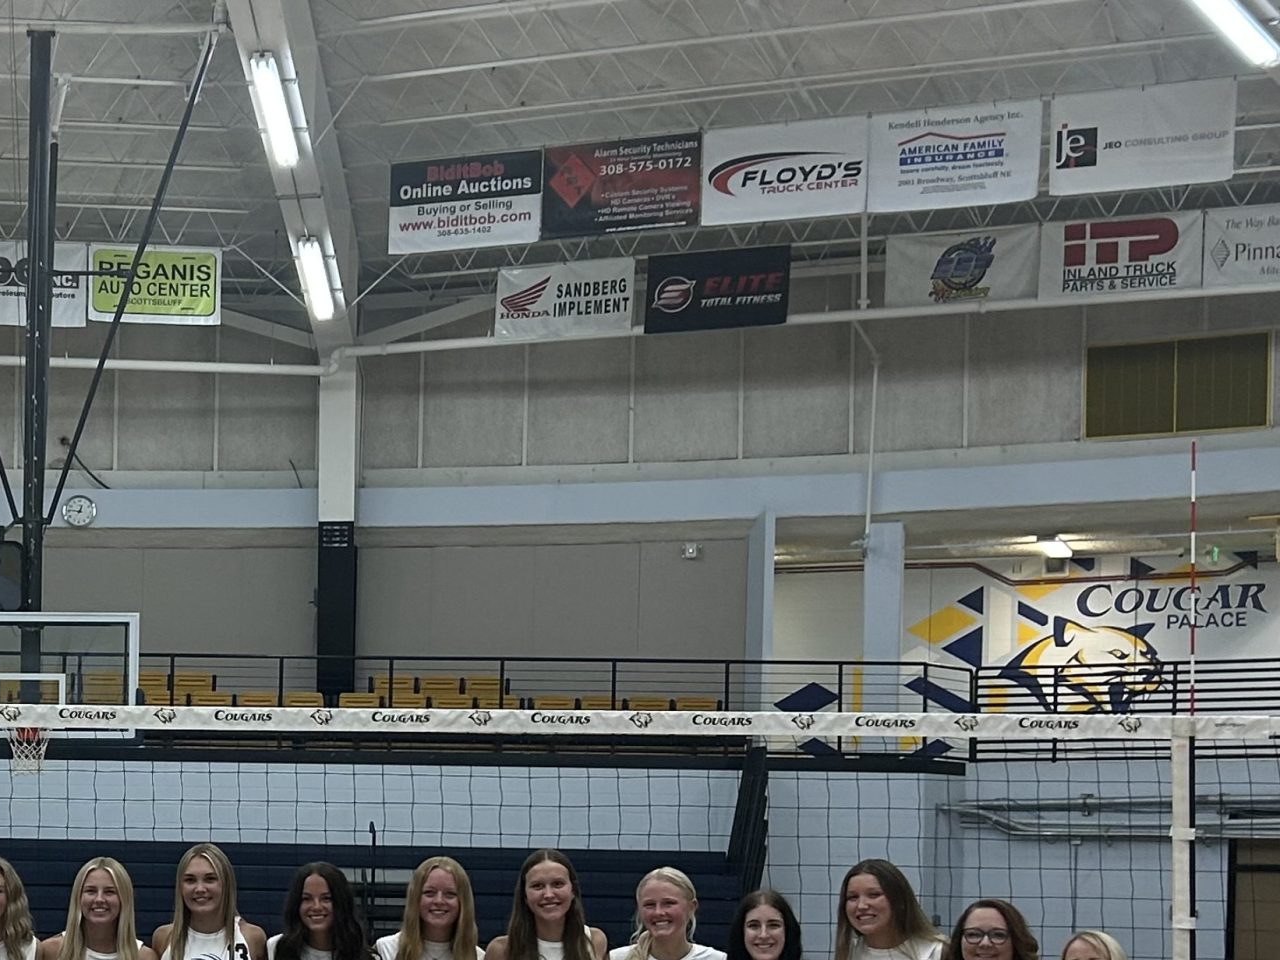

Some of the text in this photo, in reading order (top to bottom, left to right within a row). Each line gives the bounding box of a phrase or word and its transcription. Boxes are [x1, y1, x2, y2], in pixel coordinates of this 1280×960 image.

[923, 116, 971, 127] Henderson
[973, 113, 1005, 125] Agency
[1007, 111, 1023, 119] Inc.
[900, 138, 1004, 156] AMERICAN FAMILY
[1103, 130, 1229, 150] JEO CONSULTING GROUP
[594, 147, 618, 158] Alarm
[620, 145, 651, 156] Security
[652, 140, 698, 152] Technicians
[907, 150, 995, 164] INSURANCE
[599, 157, 692, 176] 308-575-0172
[741, 160, 864, 187] FLOYD'S
[917, 175, 955, 185] Broadway,
[957, 172, 999, 182] Scottsbluff
[1000, 170, 1012, 178] NE
[400, 176, 532, 199] Online Auctions
[761, 178, 858, 195] TRUCK CENTER
[417, 200, 512, 217] Buying or Selling
[399, 211, 531, 232] www.biditbob.com
[1225, 218, 1242, 229] The
[1246, 217, 1264, 231] Way
[1062, 261, 1177, 281] INLAND TRUCK
[98, 280, 210, 298] AUTO CENTER
[556, 278, 628, 299] SANDBERG
[703, 272, 784, 295] ELITE
[1062, 274, 1177, 292] PARTS & SERVICE
[126, 298, 182, 307] SCOTTSBLUFF
[553, 297, 630, 318] IMPLEMENT
[700, 293, 782, 308] TOTAL FITNESS
[500, 309, 550, 320] HONDA
[1076, 583, 1268, 617] COUGAR
[1167, 612, 1247, 630] PALACE
[58, 707, 117, 721] COUGARS
[214, 709, 273, 723] COUGARS
[371, 710, 431, 724] COUGARS
[531, 712, 592, 726] COUGARS
[691, 714, 753, 728] COUGARS
[855, 715, 916, 729] COUGARS
[1018, 716, 1079, 731] COUGARS
